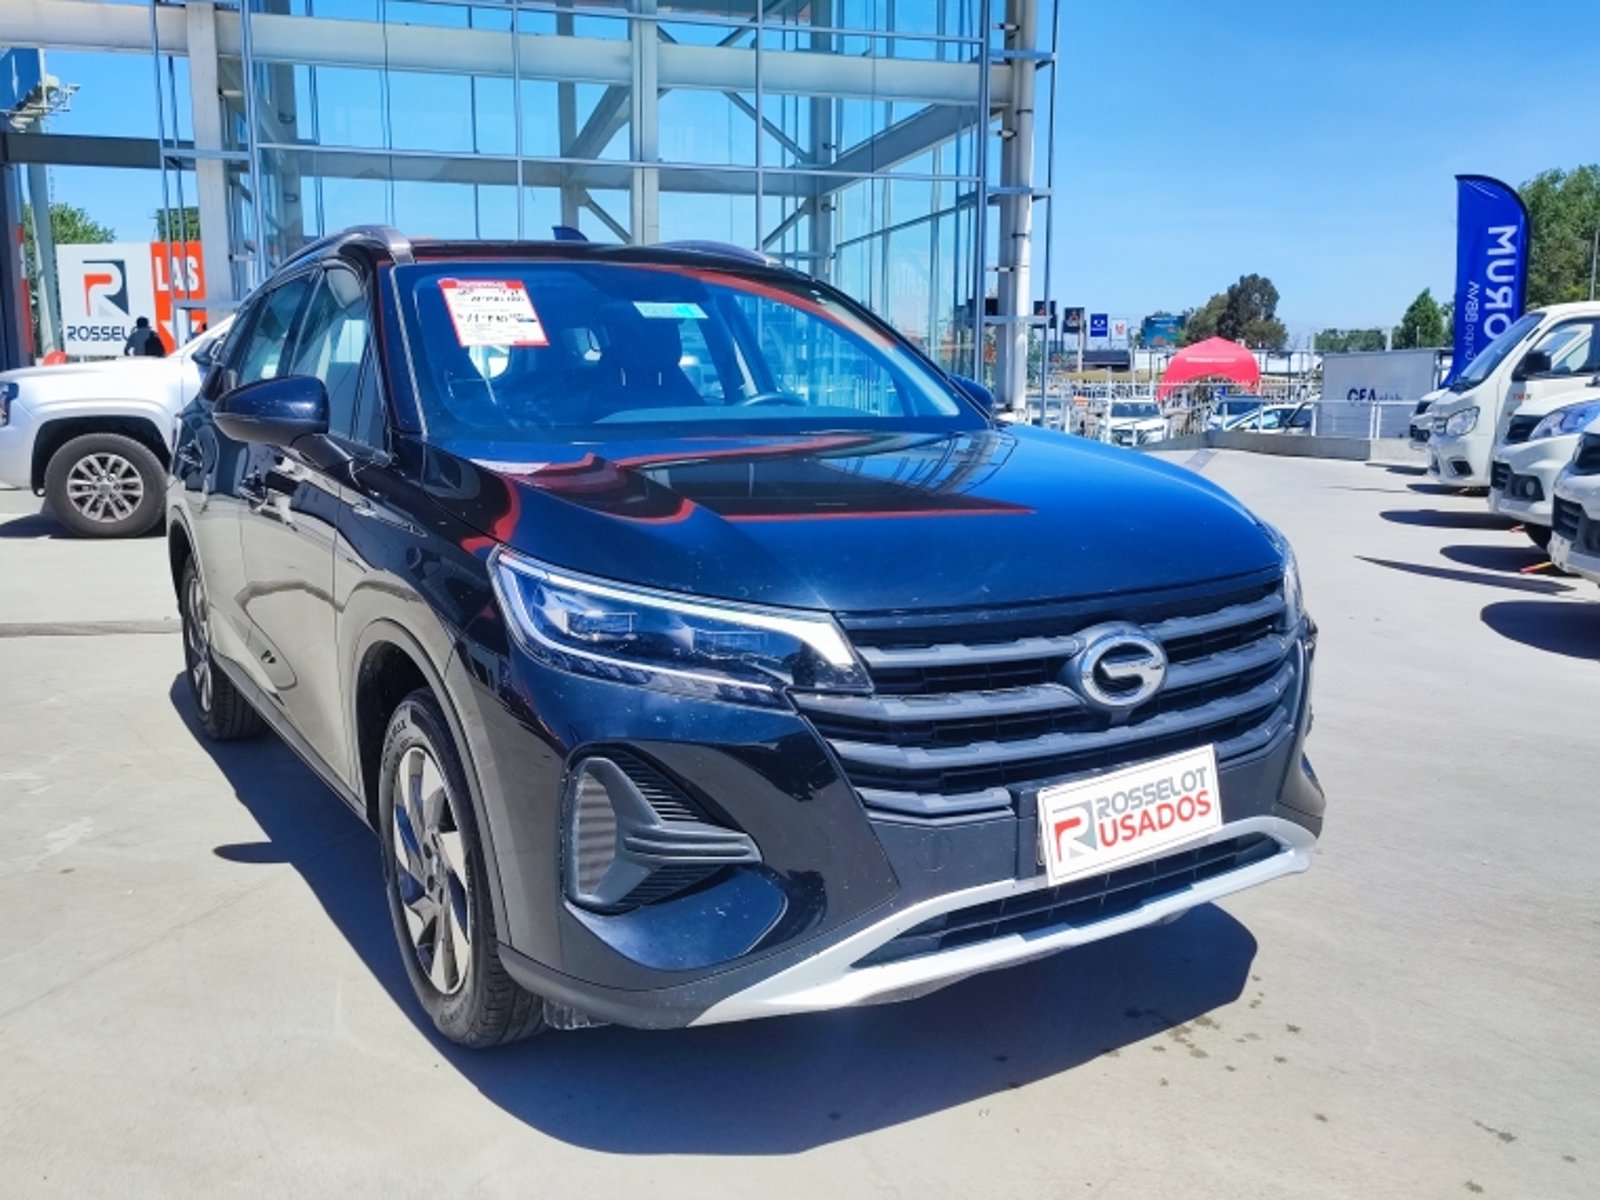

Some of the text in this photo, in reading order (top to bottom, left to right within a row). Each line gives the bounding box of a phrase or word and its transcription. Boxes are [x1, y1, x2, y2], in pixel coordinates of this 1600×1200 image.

[67, 326, 136, 341] ROSSEL
[1096, 767, 1207, 819] ROSSELOT
[1099, 790, 1211, 847] USADOS
